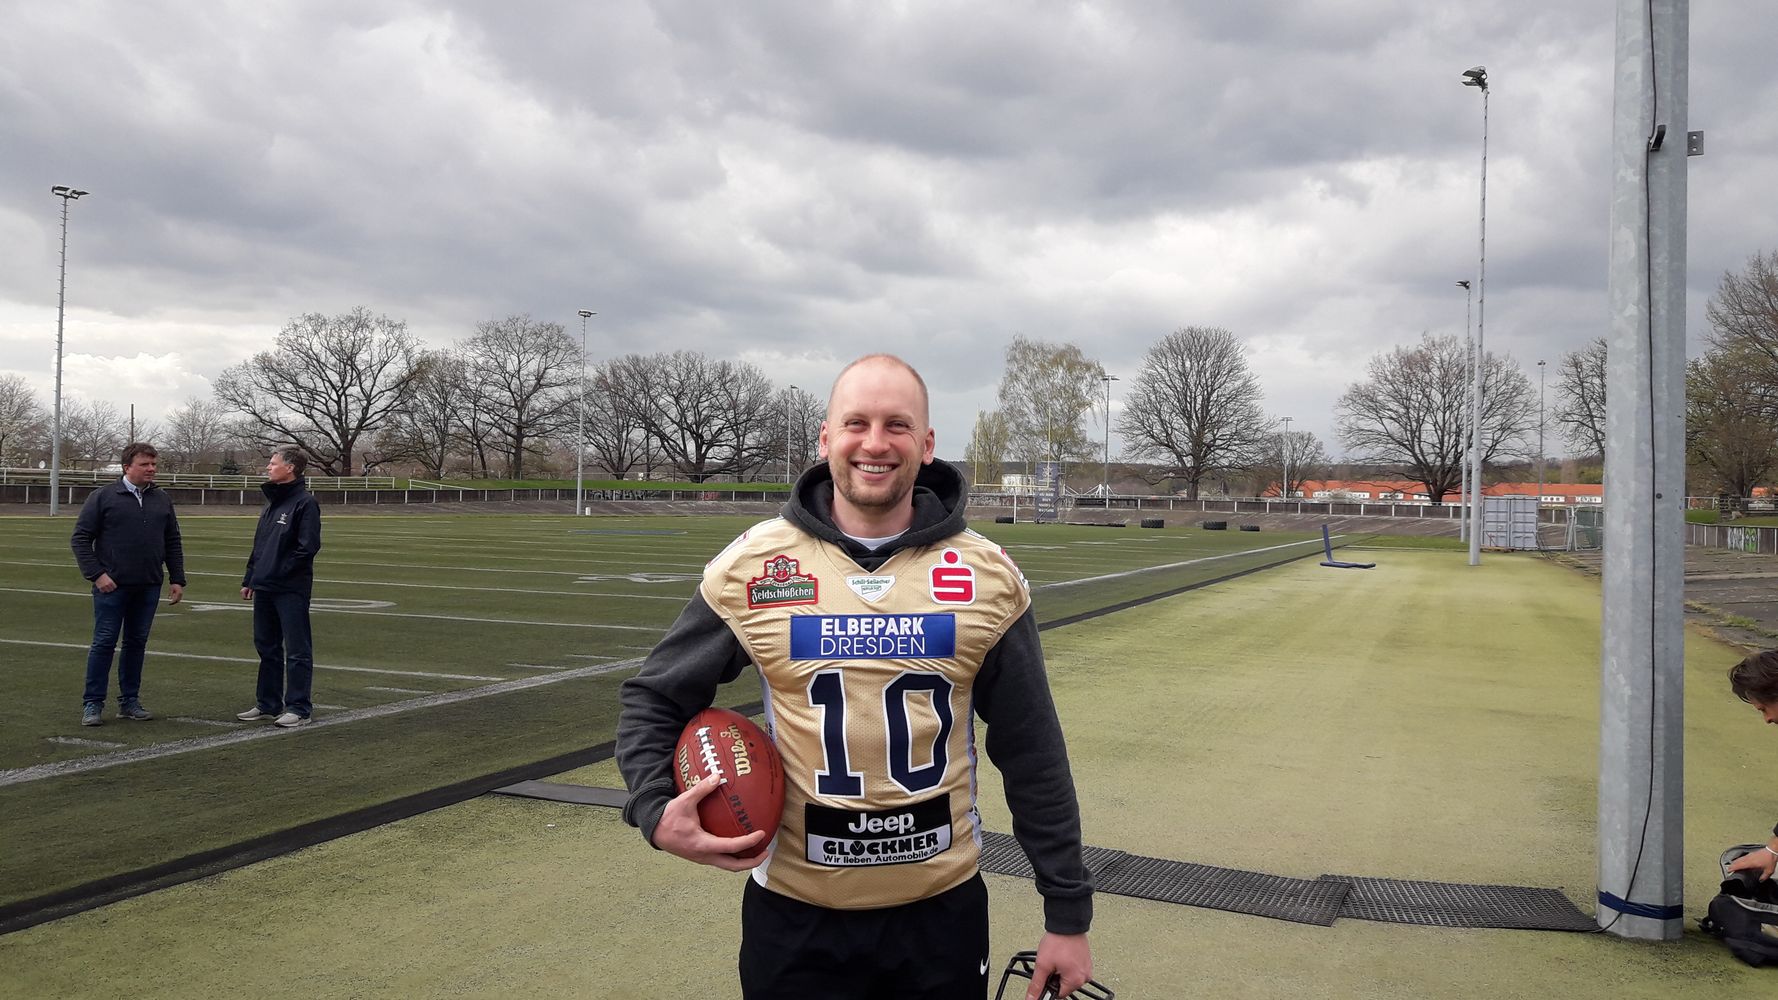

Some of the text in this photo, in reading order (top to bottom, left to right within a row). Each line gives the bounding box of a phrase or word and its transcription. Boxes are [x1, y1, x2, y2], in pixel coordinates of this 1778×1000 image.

[751, 586, 814, 604] Feldschlößchen
[821, 617, 924, 636] ELBEPARK
[820, 636, 926, 656] DRESDEN
[806, 668, 955, 799] 10
[727, 721, 752, 777] Wilson
[678, 743, 693, 791] Wilso
[848, 812, 915, 834] Jeep
[824, 846, 939, 864] Wir lieben Automobile.de
